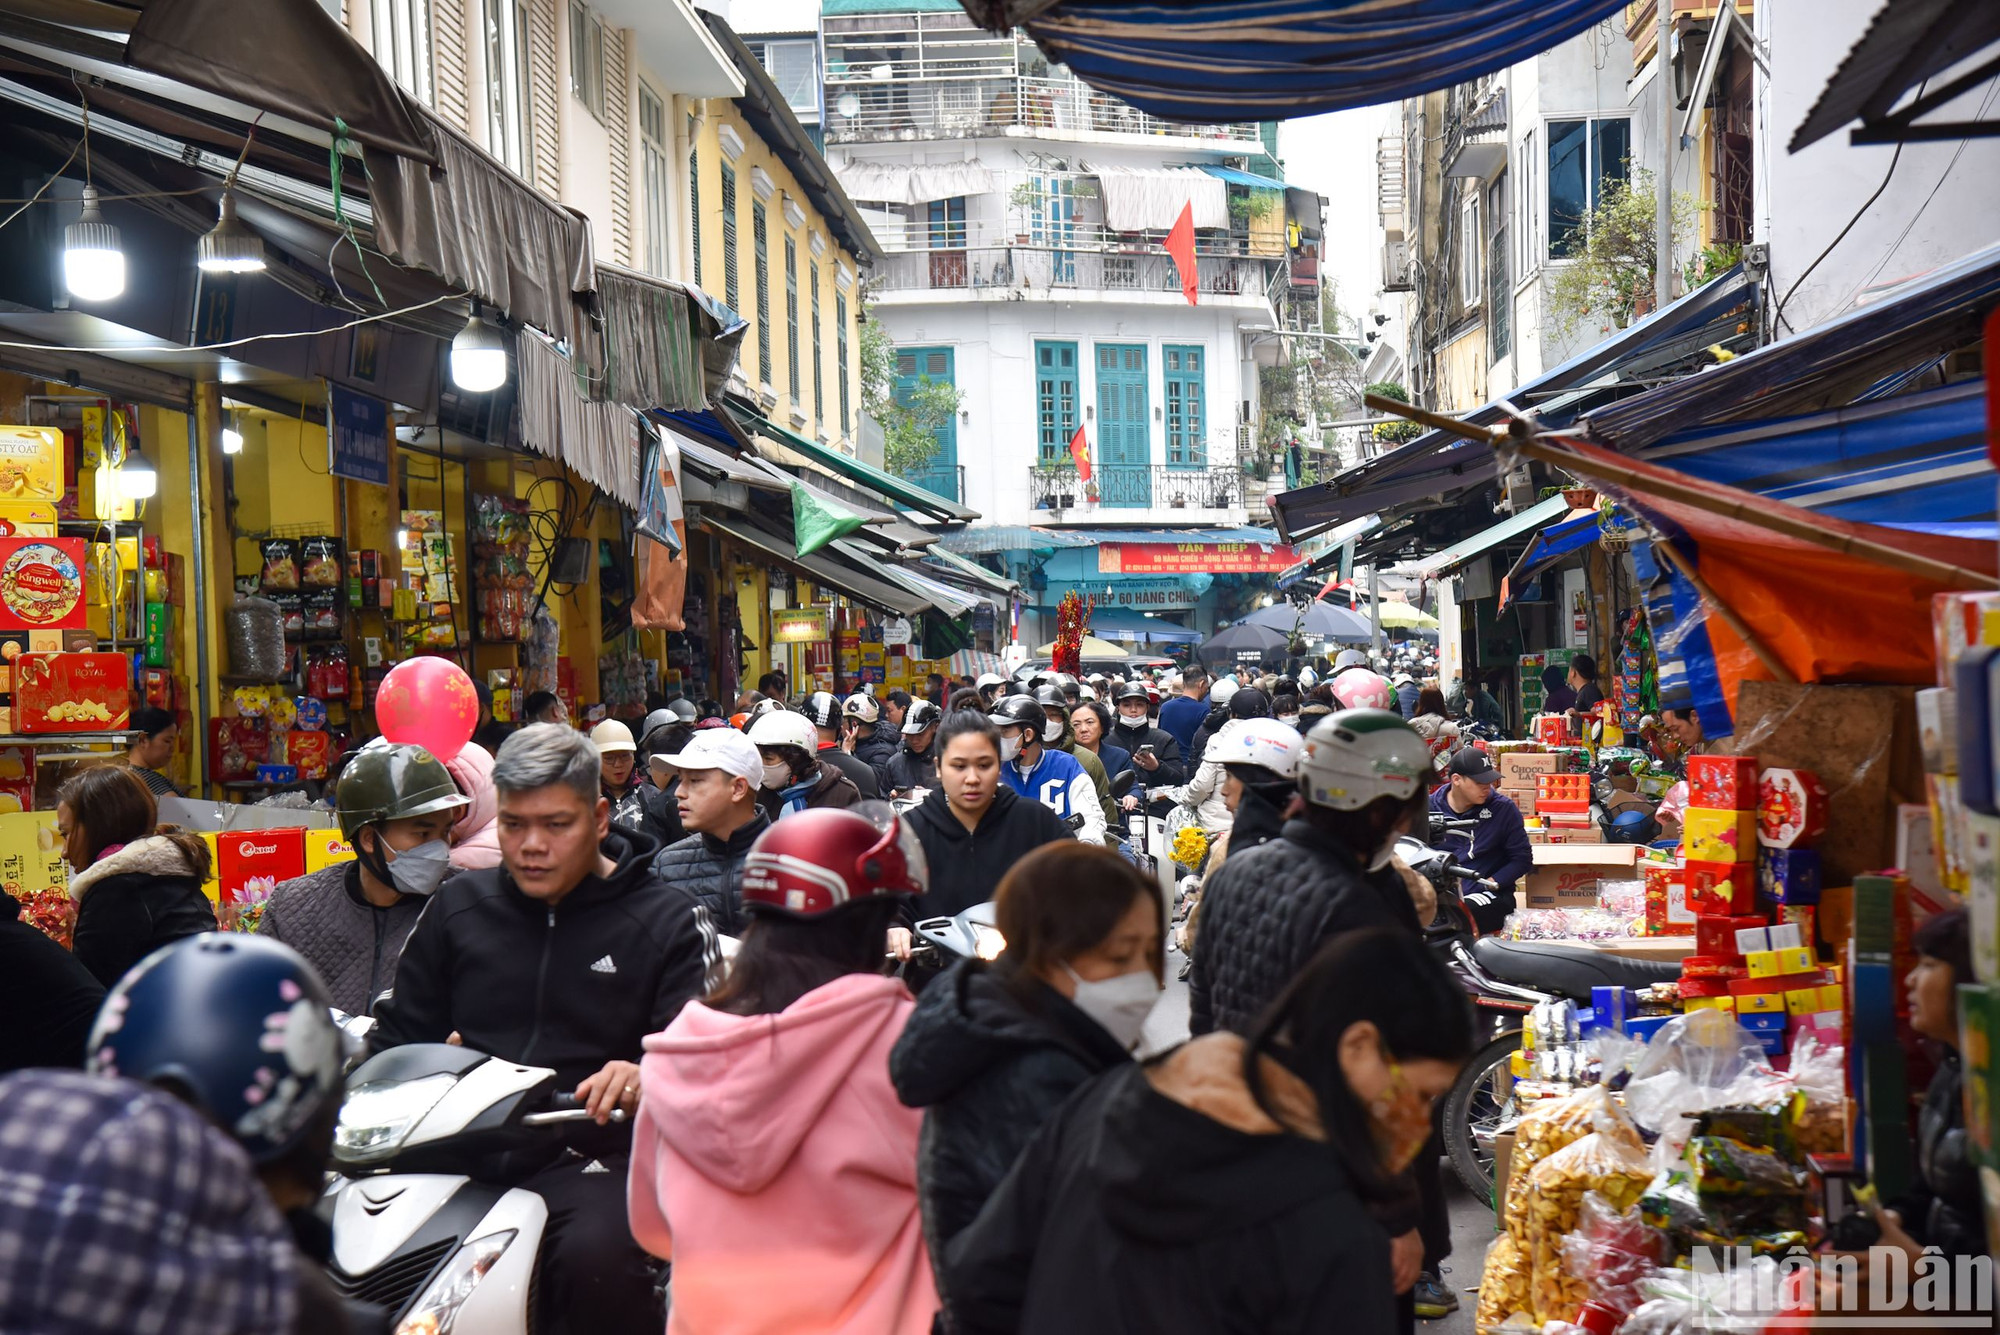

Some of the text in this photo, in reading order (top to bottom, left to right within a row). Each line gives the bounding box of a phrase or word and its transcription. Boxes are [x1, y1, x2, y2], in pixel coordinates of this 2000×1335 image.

[205, 291, 228, 342] 13
[18, 445, 39, 454] OAT
[1119, 592, 1133, 604] 60
[1135, 589, 1165, 604] HÀNG
[74, 668, 106, 679] ROYAL
[1511, 765, 1544, 774] CHOCO
[1040, 778, 1065, 816] G
[1558, 889, 1581, 898] BUTTER
